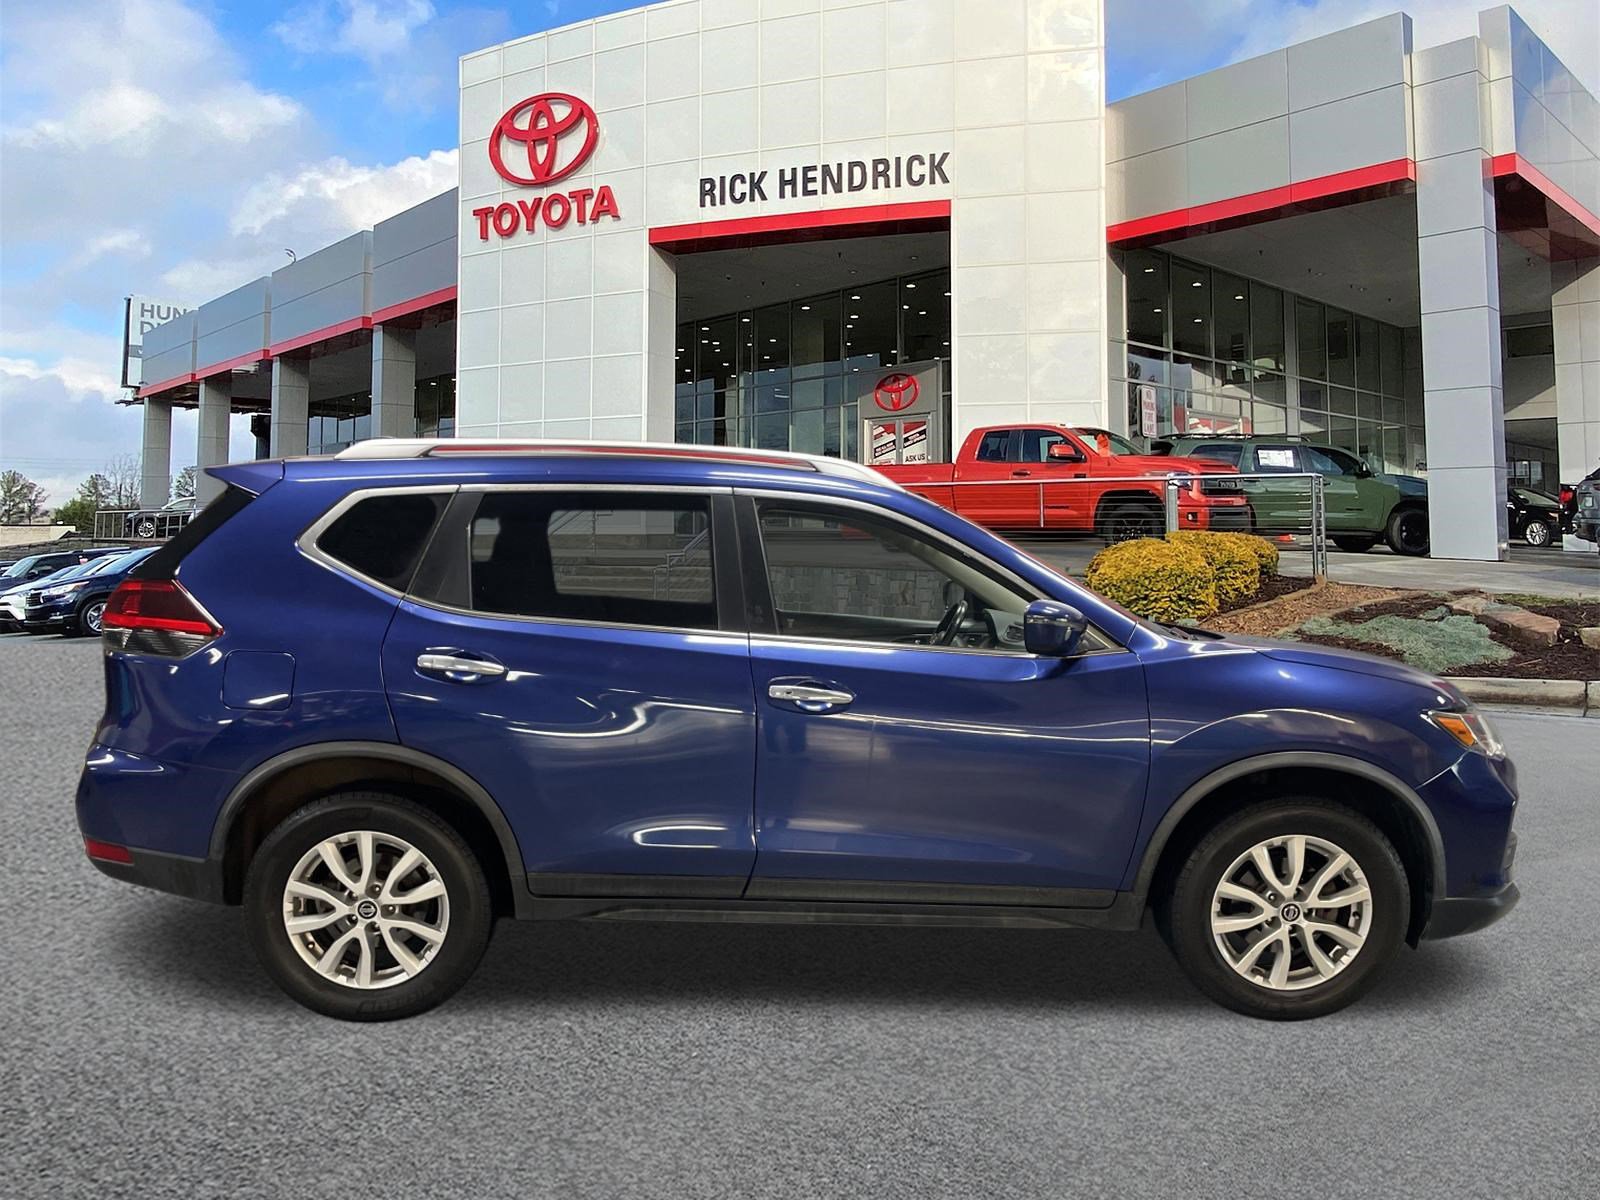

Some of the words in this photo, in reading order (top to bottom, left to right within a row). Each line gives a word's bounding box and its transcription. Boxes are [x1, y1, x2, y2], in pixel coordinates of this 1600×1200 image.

[699, 171, 768, 208] RICK
[779, 151, 951, 199] HENDRICK
[473, 185, 621, 241] TOYOTA
[905, 455, 917, 463] ASK
